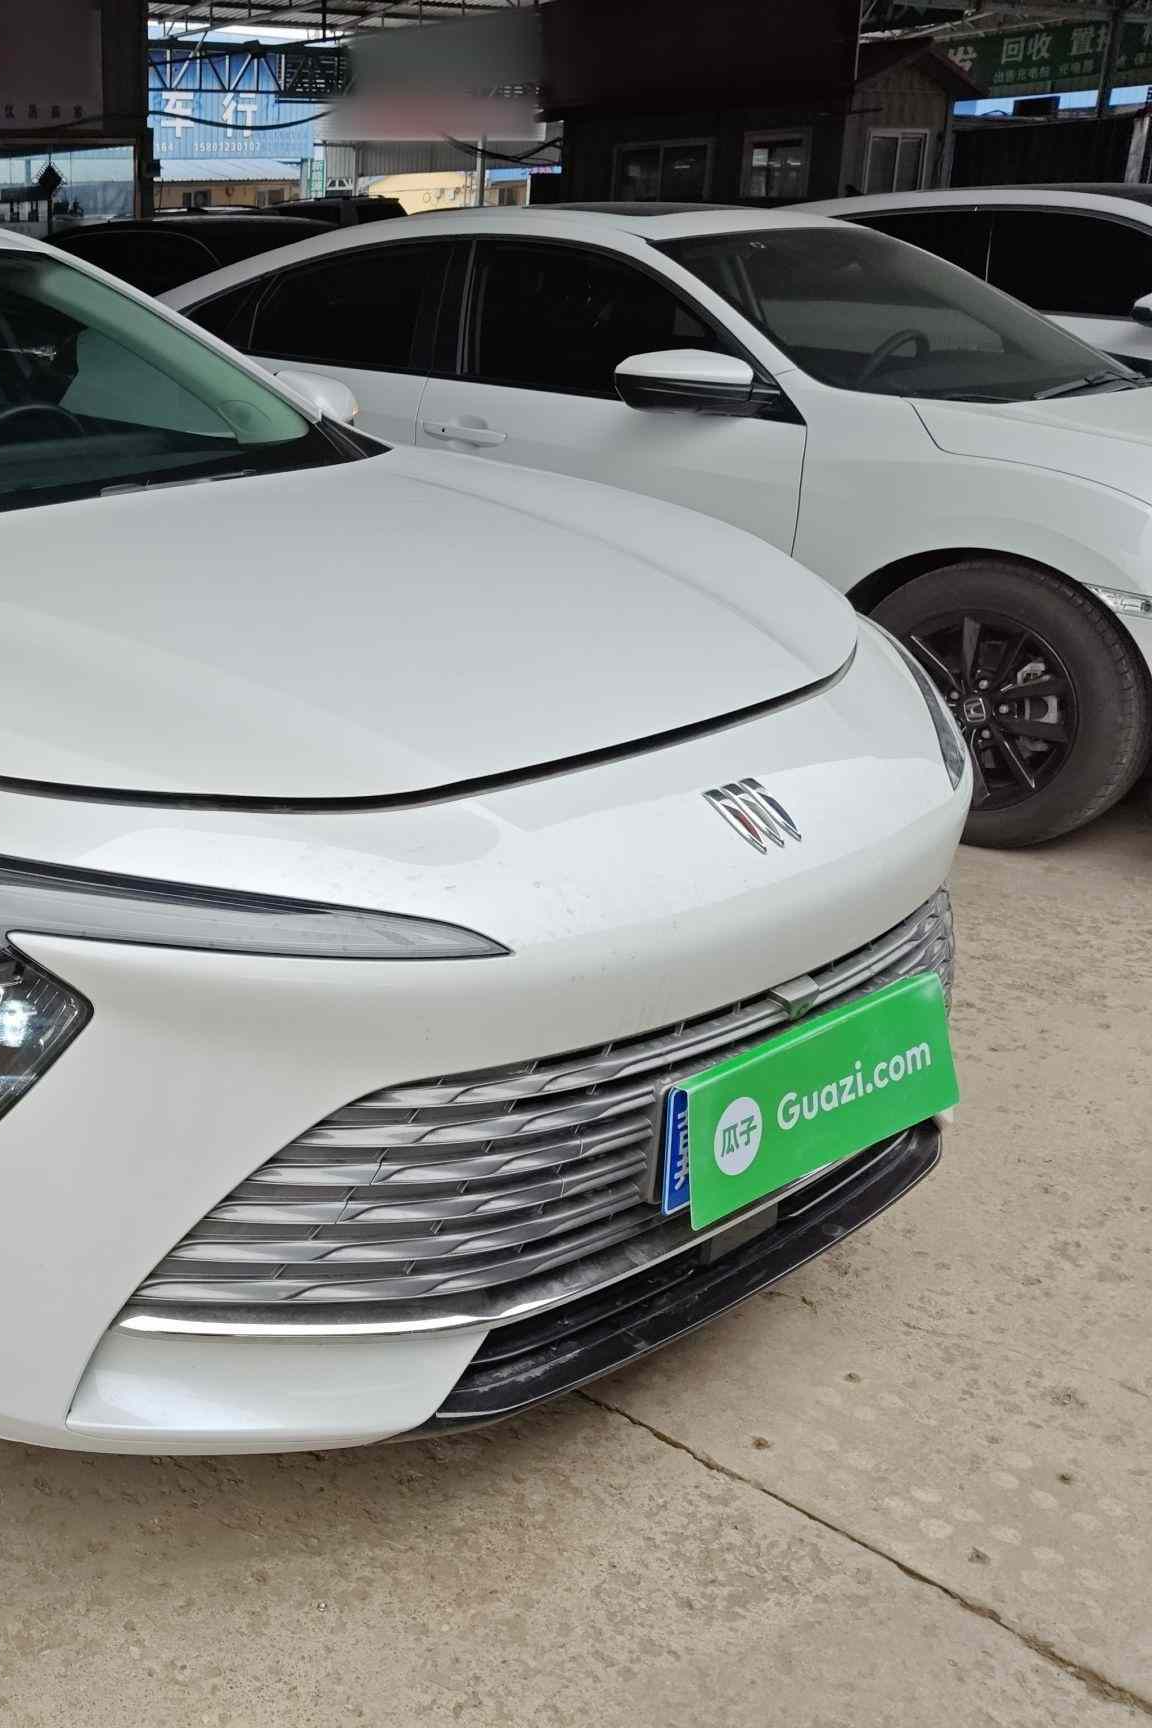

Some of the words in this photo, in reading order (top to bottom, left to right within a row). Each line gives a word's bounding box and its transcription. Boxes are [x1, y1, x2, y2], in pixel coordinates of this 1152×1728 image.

[1002, 33, 1052, 63] 回收
[160, 91, 258, 138] 车行
[720, 1115, 758, 1158] 瓜子
[777, 1042, 931, 1130] Guazi.com
